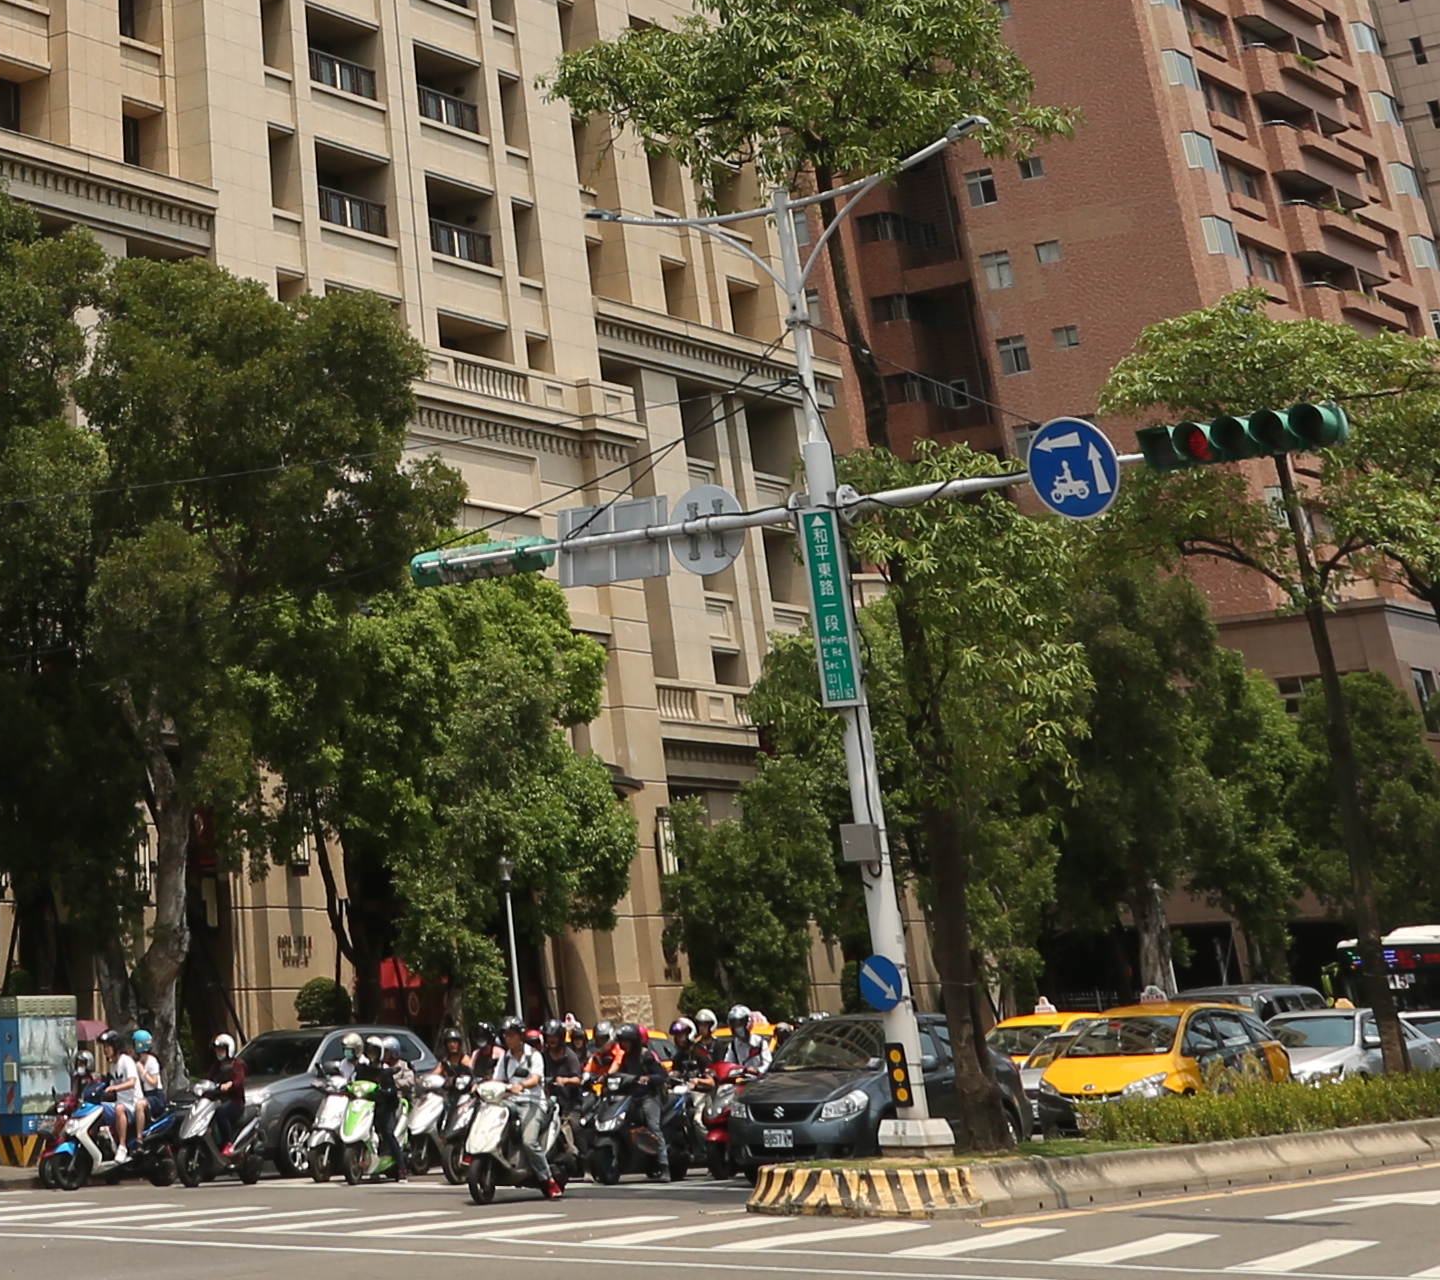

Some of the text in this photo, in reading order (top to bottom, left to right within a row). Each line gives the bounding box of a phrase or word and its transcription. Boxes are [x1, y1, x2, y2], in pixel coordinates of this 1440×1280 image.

[813, 528, 840, 632] 和平東路一段
